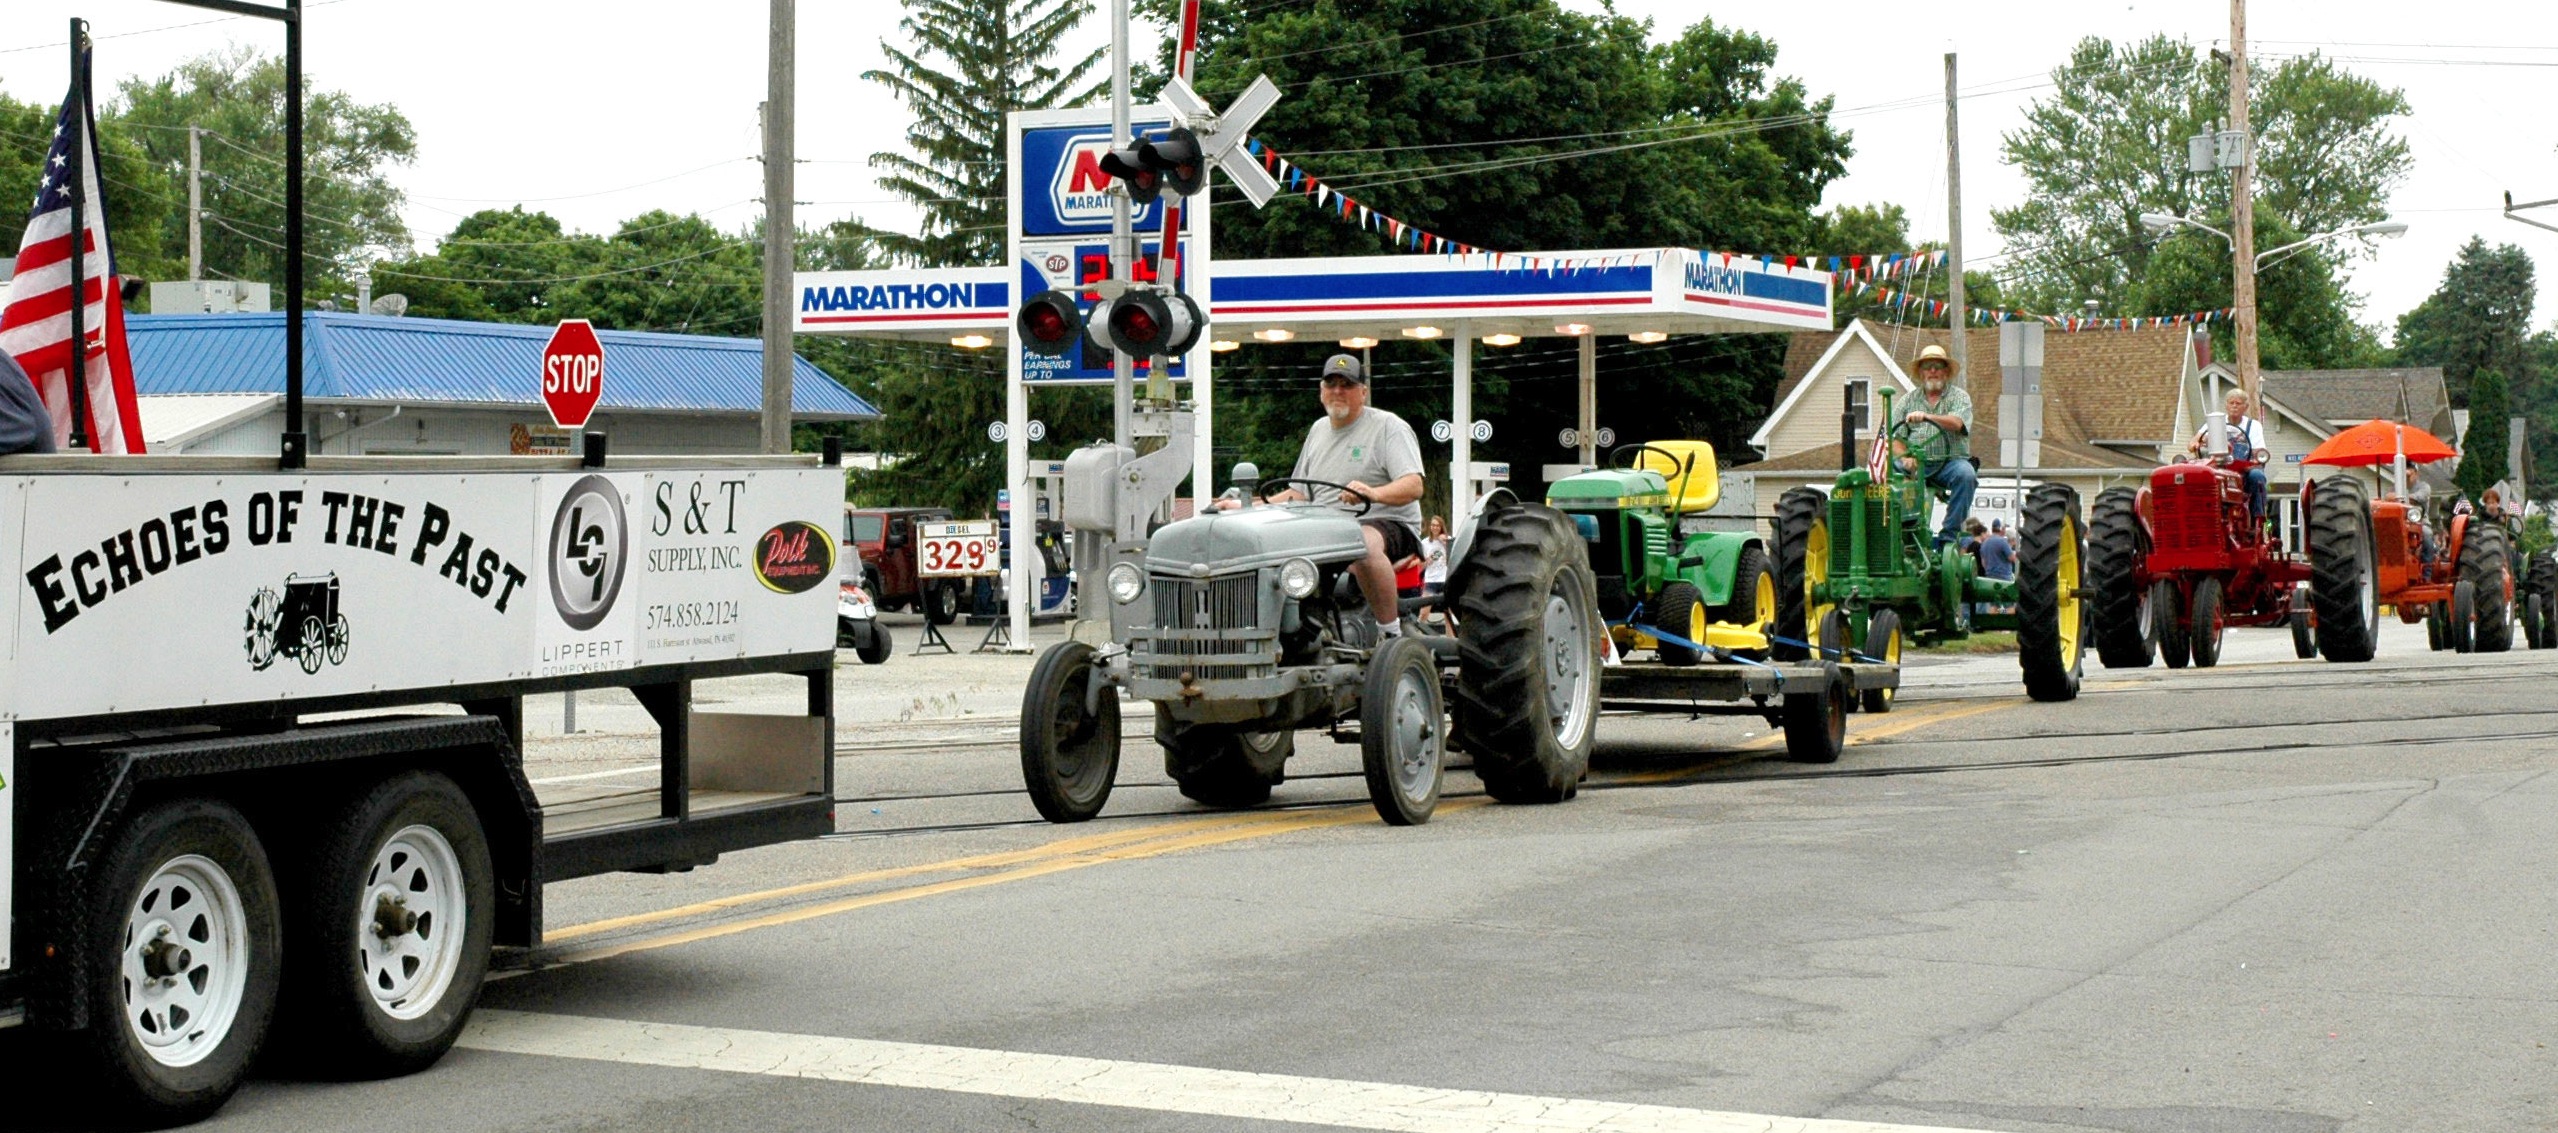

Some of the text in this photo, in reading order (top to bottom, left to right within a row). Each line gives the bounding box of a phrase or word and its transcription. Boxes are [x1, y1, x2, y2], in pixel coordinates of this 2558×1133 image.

[1048, 256, 1066, 270] STP
[1684, 261, 1741, 296] MARATHON
[801, 282, 973, 312] MARATHON
[546, 354, 599, 394] STOP
[1024, 370, 1053, 379] UP TO
[994, 426, 1002, 437] 3
[1031, 425, 1039, 435] 4
[1438, 425, 1446, 436] 7
[1478, 426, 1486, 437] 8
[652, 480, 745, 537] S & T
[986, 538, 997, 554] 9
[25, 490, 528, 635] ECHOES OF THE PAST
[647, 545, 742, 574] SUPPLY, INC.
[647, 600, 738, 630] 574.858.2124
[543, 640, 623, 662] LIPPERT
[542, 660, 622, 677] COMPONENTS
